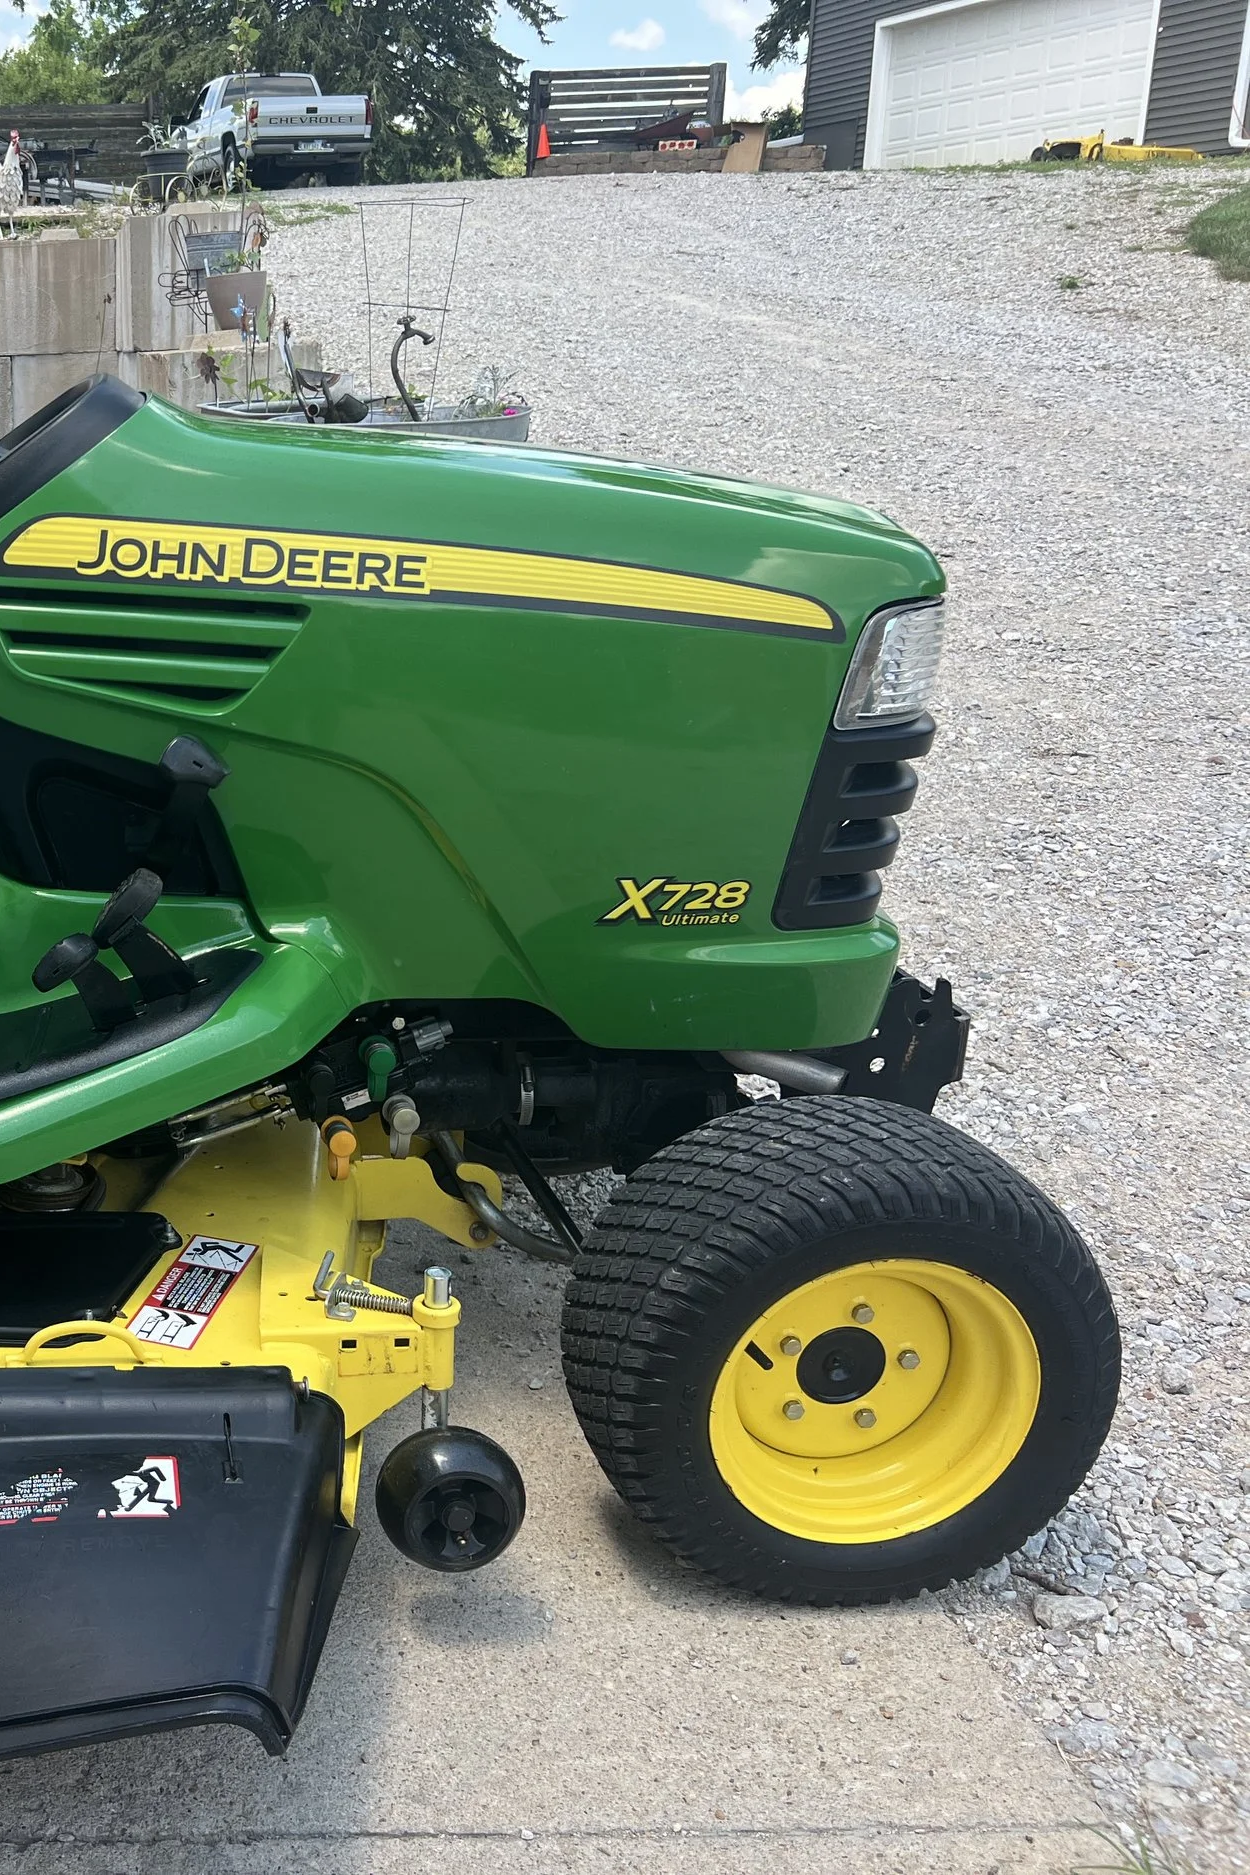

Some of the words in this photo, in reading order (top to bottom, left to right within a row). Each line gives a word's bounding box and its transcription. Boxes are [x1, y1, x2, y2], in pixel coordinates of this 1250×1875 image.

[269, 115, 355, 125] CHEVROLET
[76, 529, 227, 578] JOHN
[240, 537, 428, 589] DEERE
[600, 877, 751, 921] X728
[661, 913, 740, 926] Ultimate
[156, 1267, 184, 1294] DANGER
